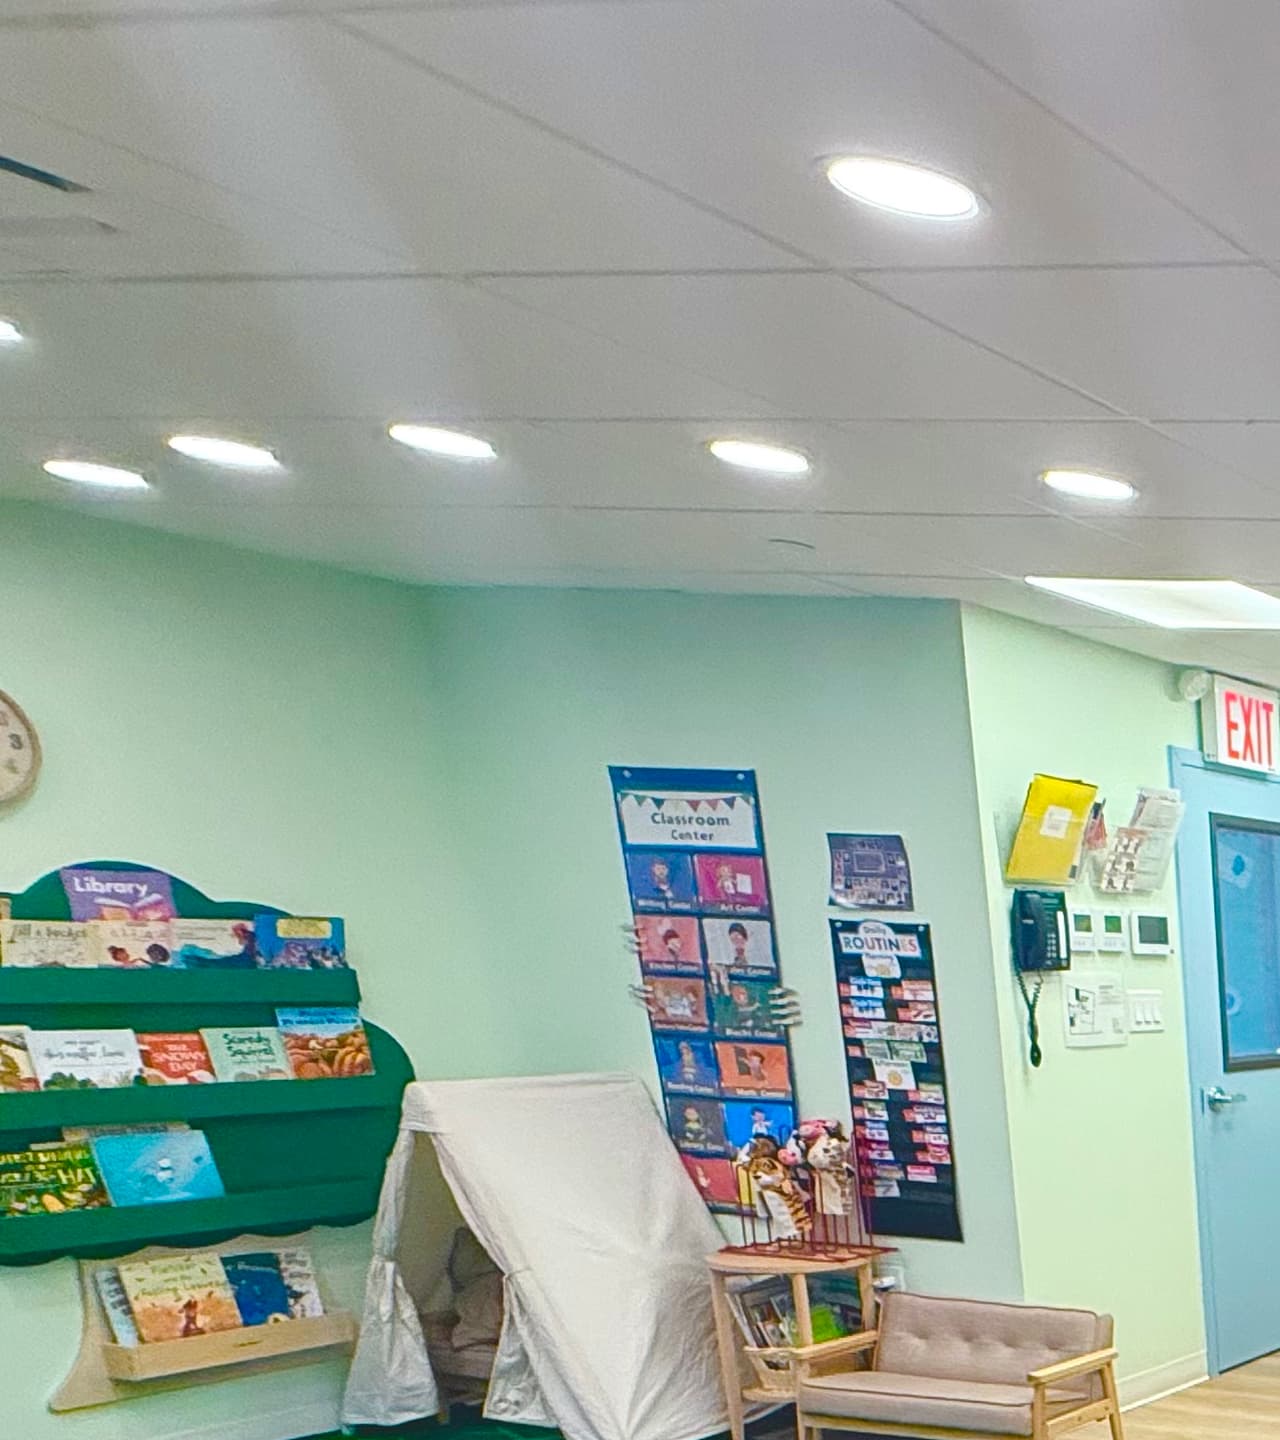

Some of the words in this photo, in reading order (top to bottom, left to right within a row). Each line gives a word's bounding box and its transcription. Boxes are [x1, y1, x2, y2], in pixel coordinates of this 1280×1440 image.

[1225, 691, 1274, 767] EXIT
[650, 812, 730, 826] Classroom
[671, 829, 714, 841] Center
[73, 876, 148, 897] Library
[843, 936, 917, 953] ROUTINES
